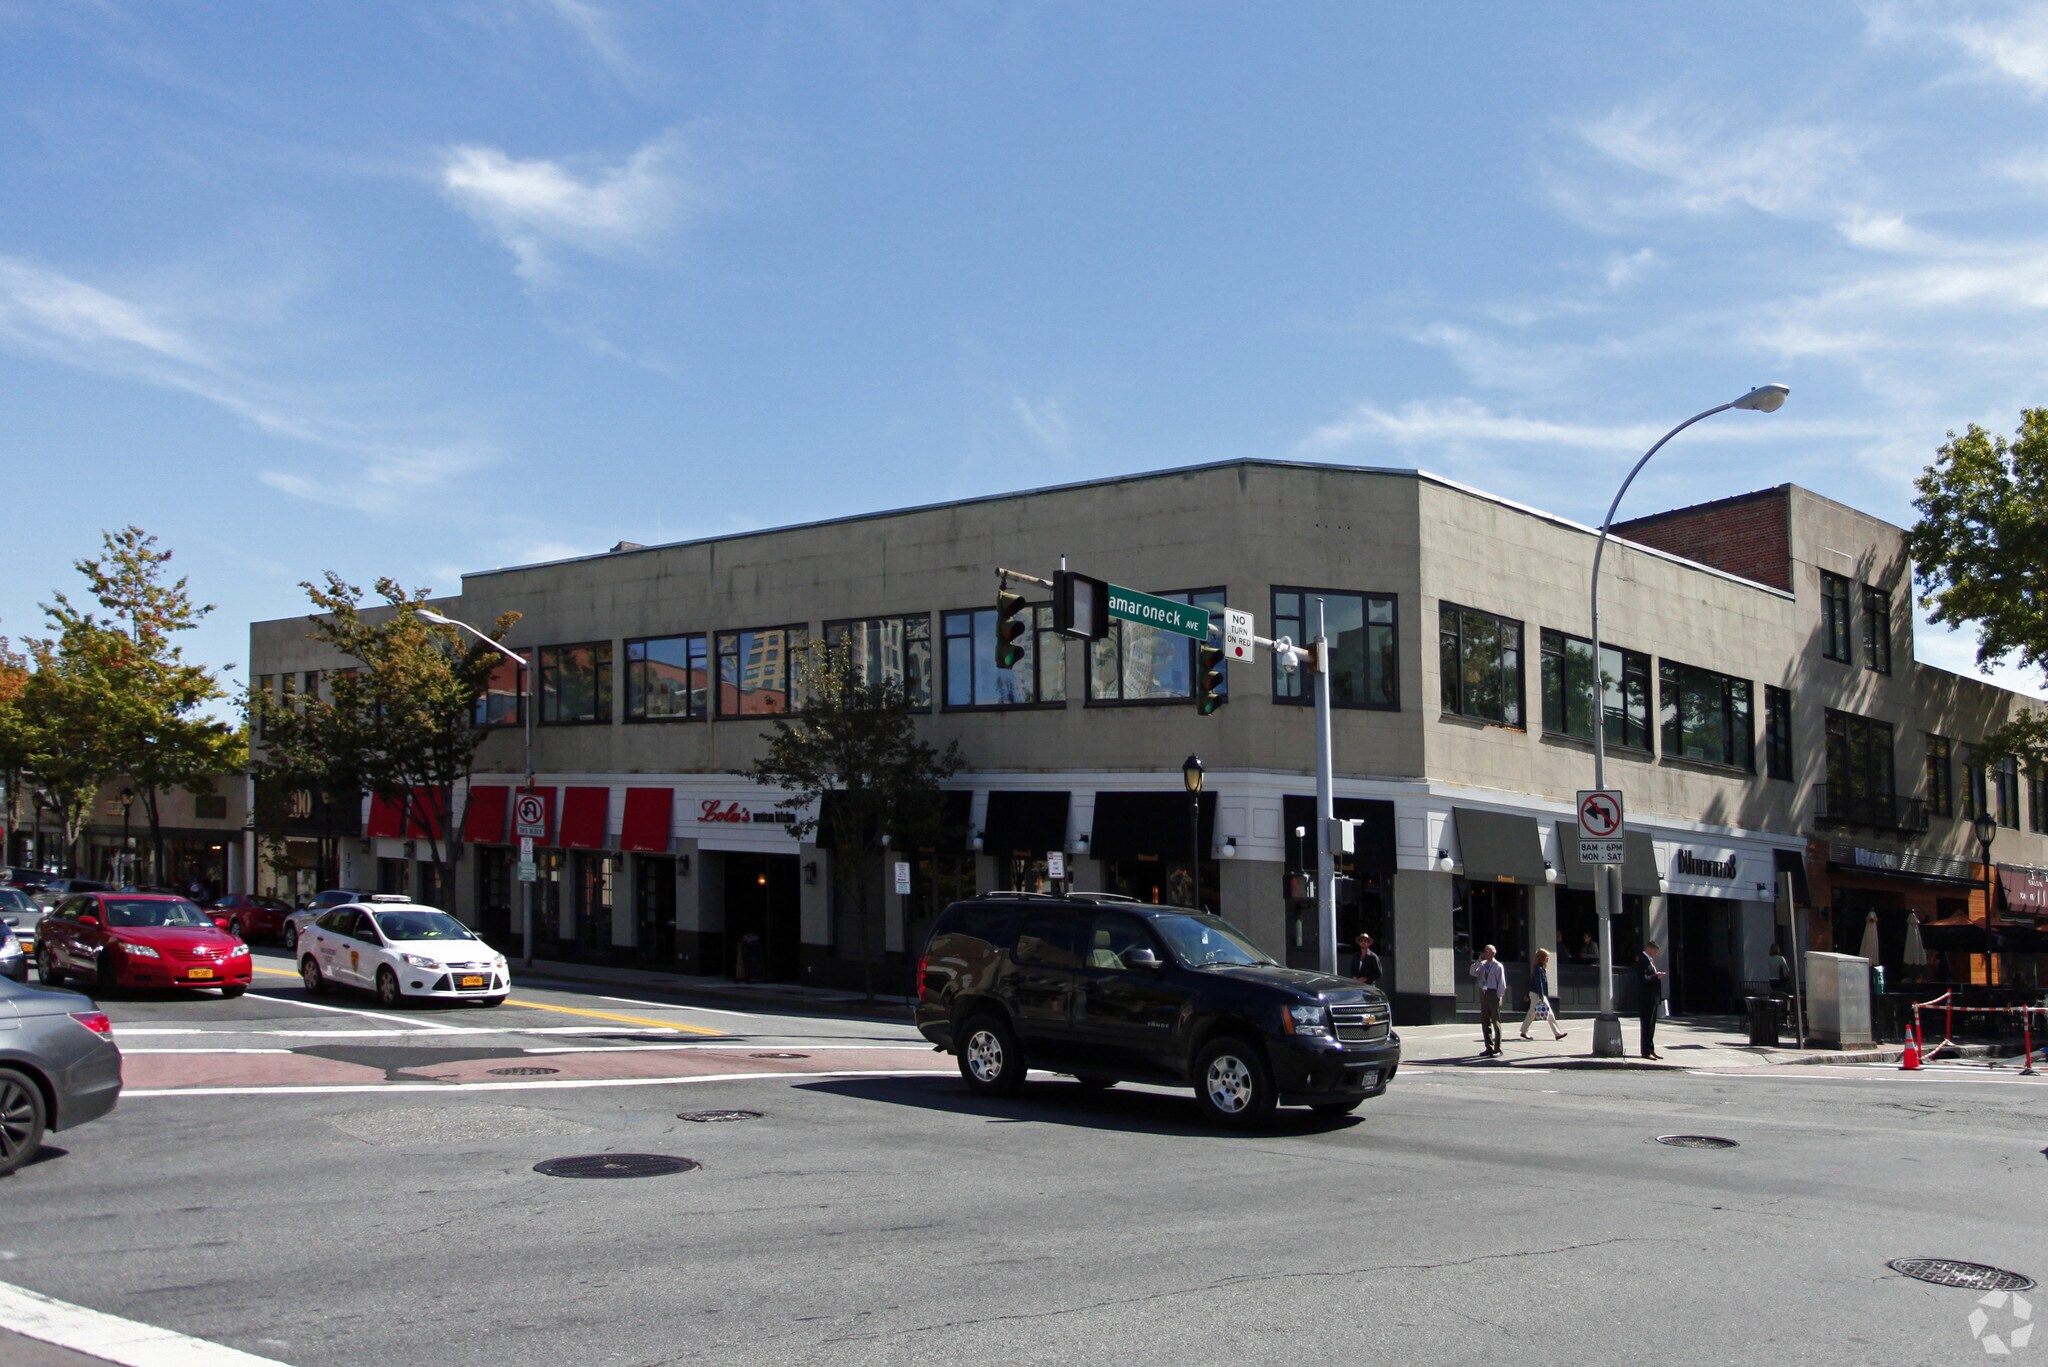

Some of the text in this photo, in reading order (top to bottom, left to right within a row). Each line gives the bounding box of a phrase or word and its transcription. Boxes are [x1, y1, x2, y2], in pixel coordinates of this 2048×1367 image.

[1108, 596, 1199, 631] amaroneck AVE
[1232, 614, 1246, 625] NO
[1231, 625, 1248, 636] TURN
[1227, 634, 1251, 647] ON RED
[697, 799, 750, 823] Lola's
[1581, 843, 1598, 851] 8AM
[1606, 843, 1623, 852] 6PM
[1582, 852, 1599, 861] MON
[1607, 853, 1622, 861] SAT
